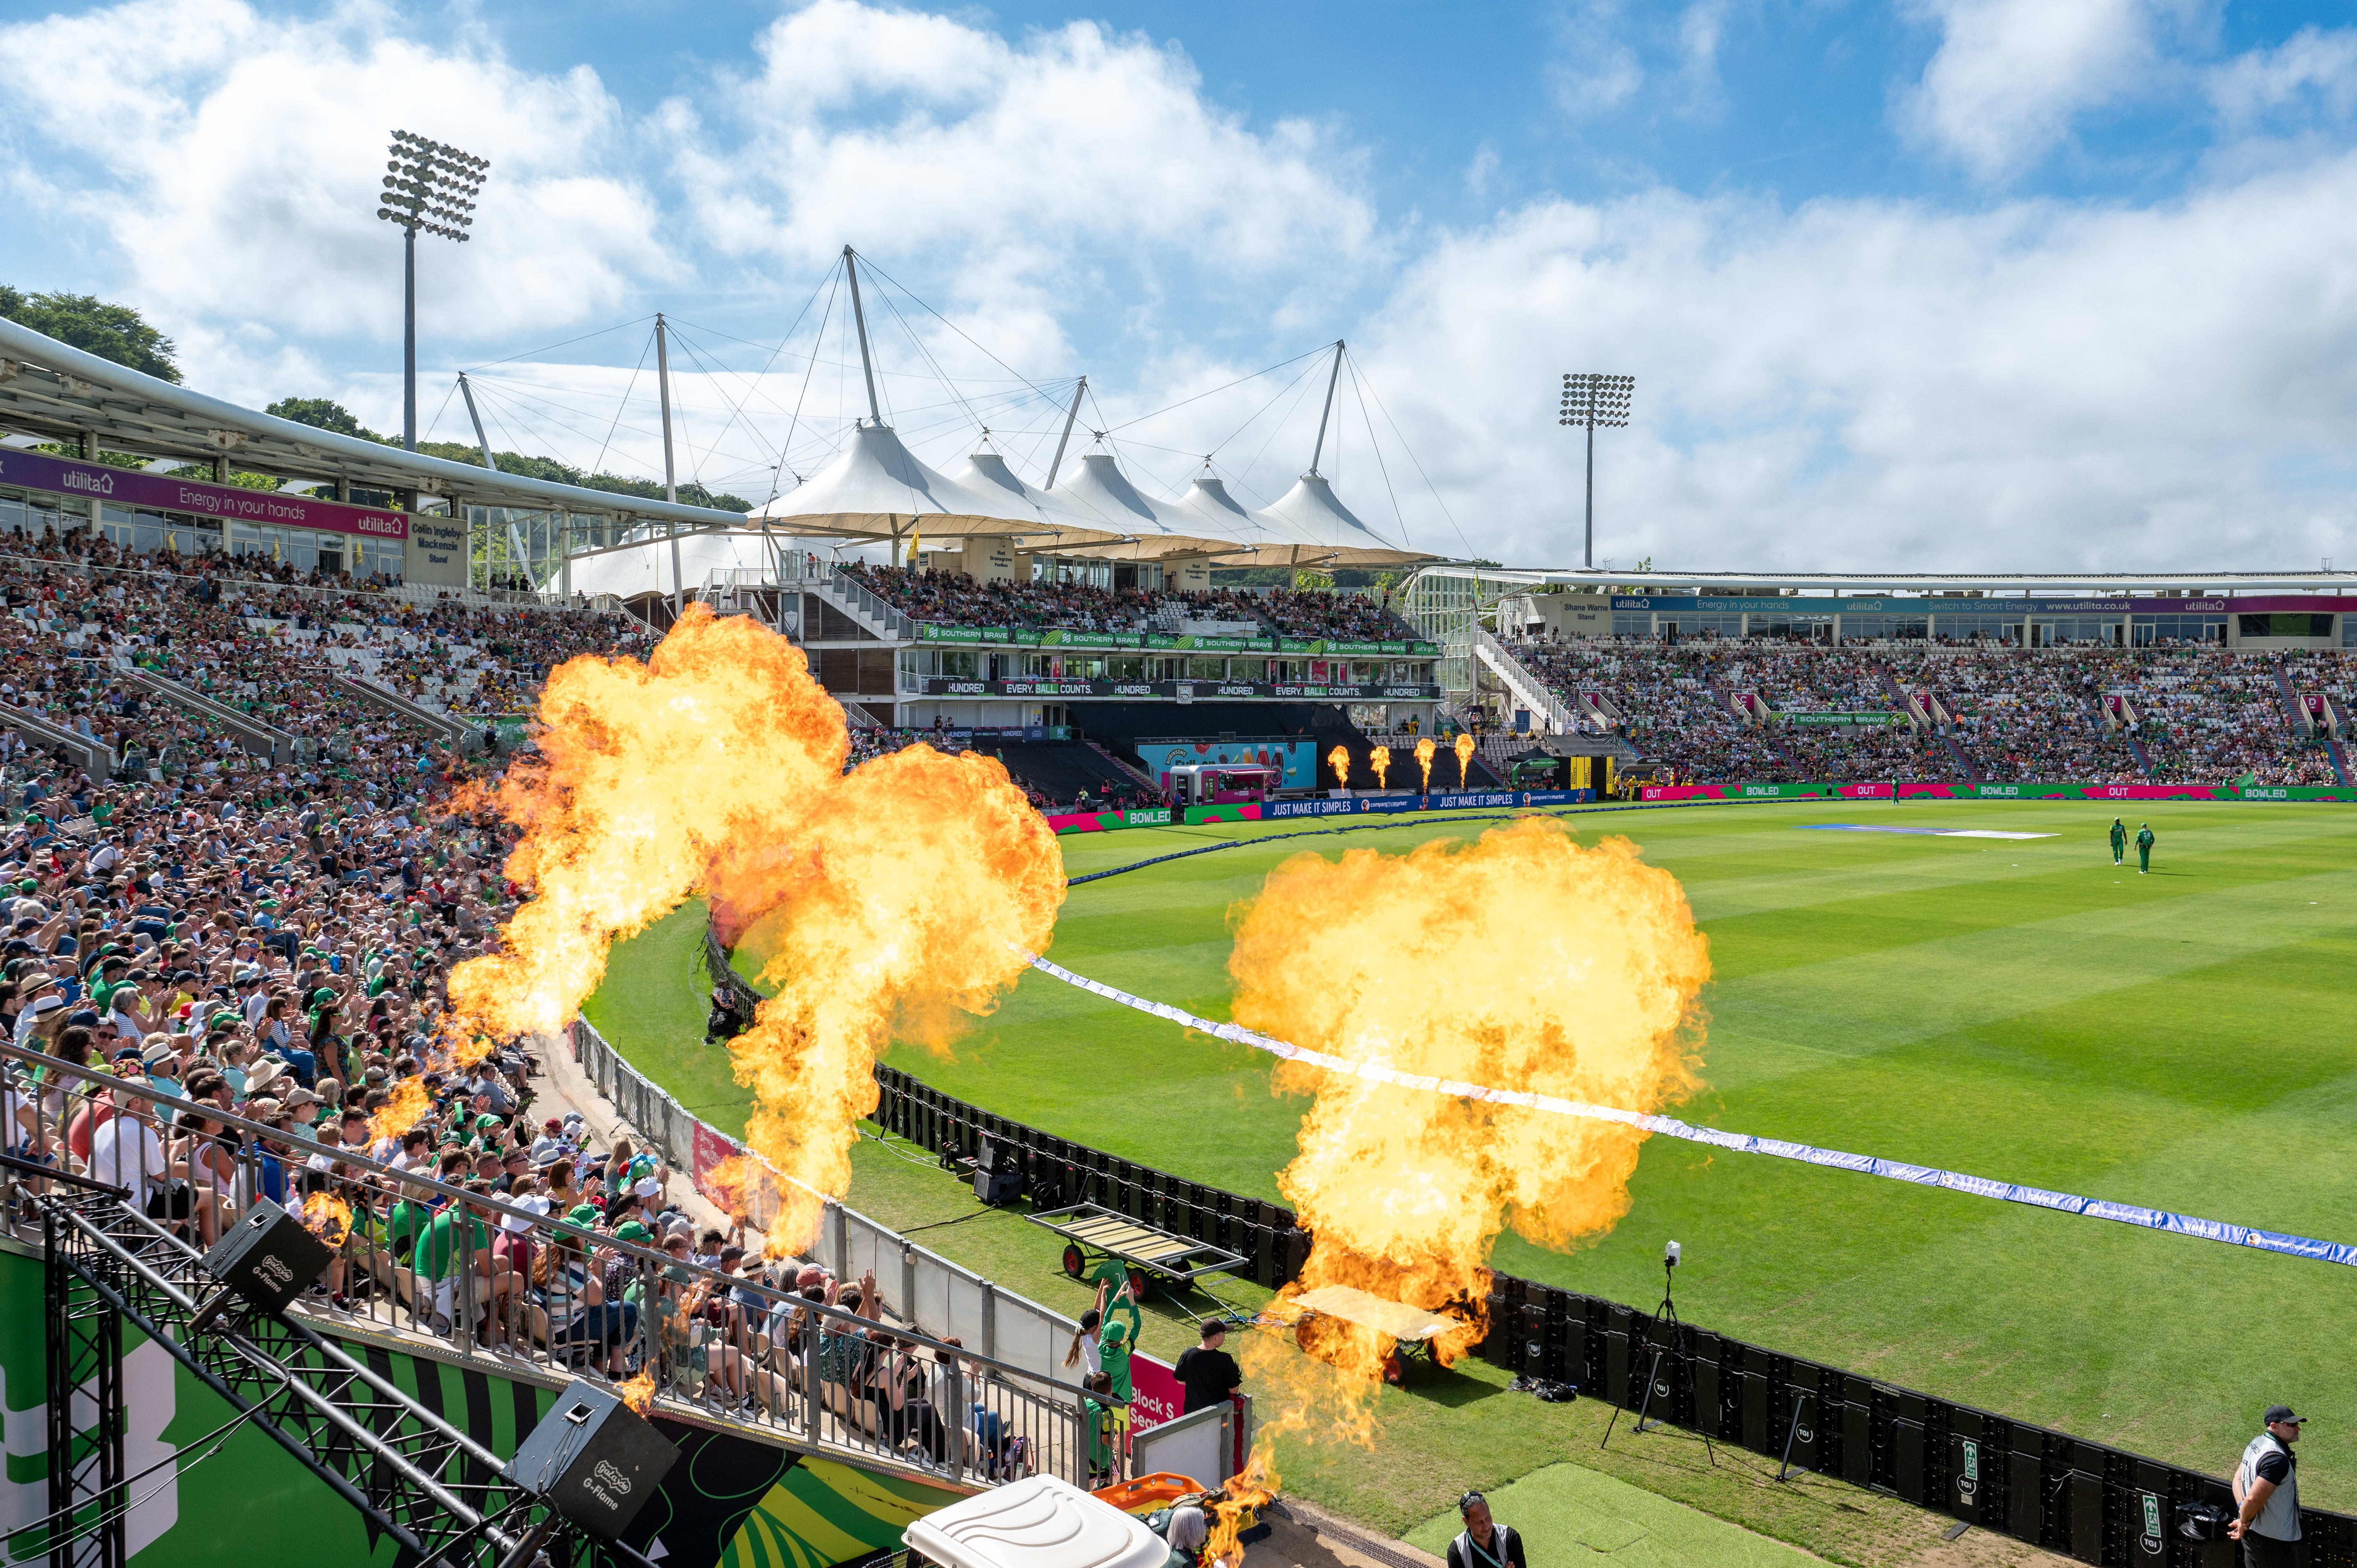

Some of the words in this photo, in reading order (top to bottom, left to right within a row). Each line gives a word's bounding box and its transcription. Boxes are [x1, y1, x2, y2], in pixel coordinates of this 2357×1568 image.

[63, 471, 100, 492] utilita
[180, 487, 221, 512] Energy
[225, 494, 234, 510] in
[238, 500, 265, 514] your
[268, 501, 305, 519] hands
[358, 516, 391, 533] utilita
[412, 523, 432, 535] Colin
[434, 526, 463, 539] Ingleby-
[418, 537, 458, 551] Mackenzie
[429, 554, 448, 563] Stand
[1616, 600, 1640, 608] utilita
[1697, 600, 1727, 610] Energy
[1761, 601, 1789, 609] hands
[1847, 602, 1873, 610] utilita
[2006, 602, 2038, 612] Energy
[2047, 602, 2131, 610] www.utilita.co.uk
[2186, 601, 2214, 610] utilita
[949, 683, 984, 692] HUNDRED
[1007, 684, 1033, 693] EVERY.
[1036, 684, 1058, 694] BALL.
[1061, 685, 1092, 694] COUNTS.
[1115, 685, 1150, 694] HUNDRED
[1218, 686, 1253, 695] HUNDRED
[1276, 687, 1302, 695] EVERY.
[1305, 687, 1326, 696] BALL.
[1329, 688, 1361, 696] COUNTS.
[2107, 697, 2115, 705] D
[2309, 697, 2316, 706] D
[1166, 749, 1186, 764] ROBINSONS
[1646, 790, 1661, 798] OUT
[1747, 787, 1779, 795] BOWLED
[1858, 786, 1875, 794] OUT
[1981, 786, 2018, 795] BOWLED
[2109, 787, 2129, 796] OUT
[2245, 789, 2286, 798] BOWLED
[1440, 797, 1457, 807] JUST
[1458, 796, 1476, 806] MAKE
[1478, 795, 1485, 806] IT
[1486, 794, 1513, 806] SIMPLES
[1273, 804, 1291, 815] JUST
[1293, 803, 1312, 814] MAKE
[1314, 802, 1320, 813] IT
[1322, 801, 1350, 812] SIMPLES
[1130, 811, 1171, 824] BOWLED
[519, 1097, 533, 1106] OUT
[1891, 1167, 1918, 1177] SIMPLES
[2029, 1194, 2059, 1204] SIMPLES
[2100, 1208, 2153, 1222] comparethemarket
[2183, 1222, 2219, 1235] SIMPLES
[2262, 1238, 2323, 1254] comparethemarket
[353, 1247, 368, 1255] OUT
[252, 1266, 282, 1293] G-Flame
[1656, 1384, 1665, 1392] TGI
[1132, 1386, 1163, 1416] Block
[1166, 1402, 1173, 1419] S
[1799, 1428, 1809, 1437] TGI
[1960, 1480, 1972, 1489] TGI
[583, 1478, 618, 1510] G-Flame
[2144, 1538, 2157, 1548] TGI
